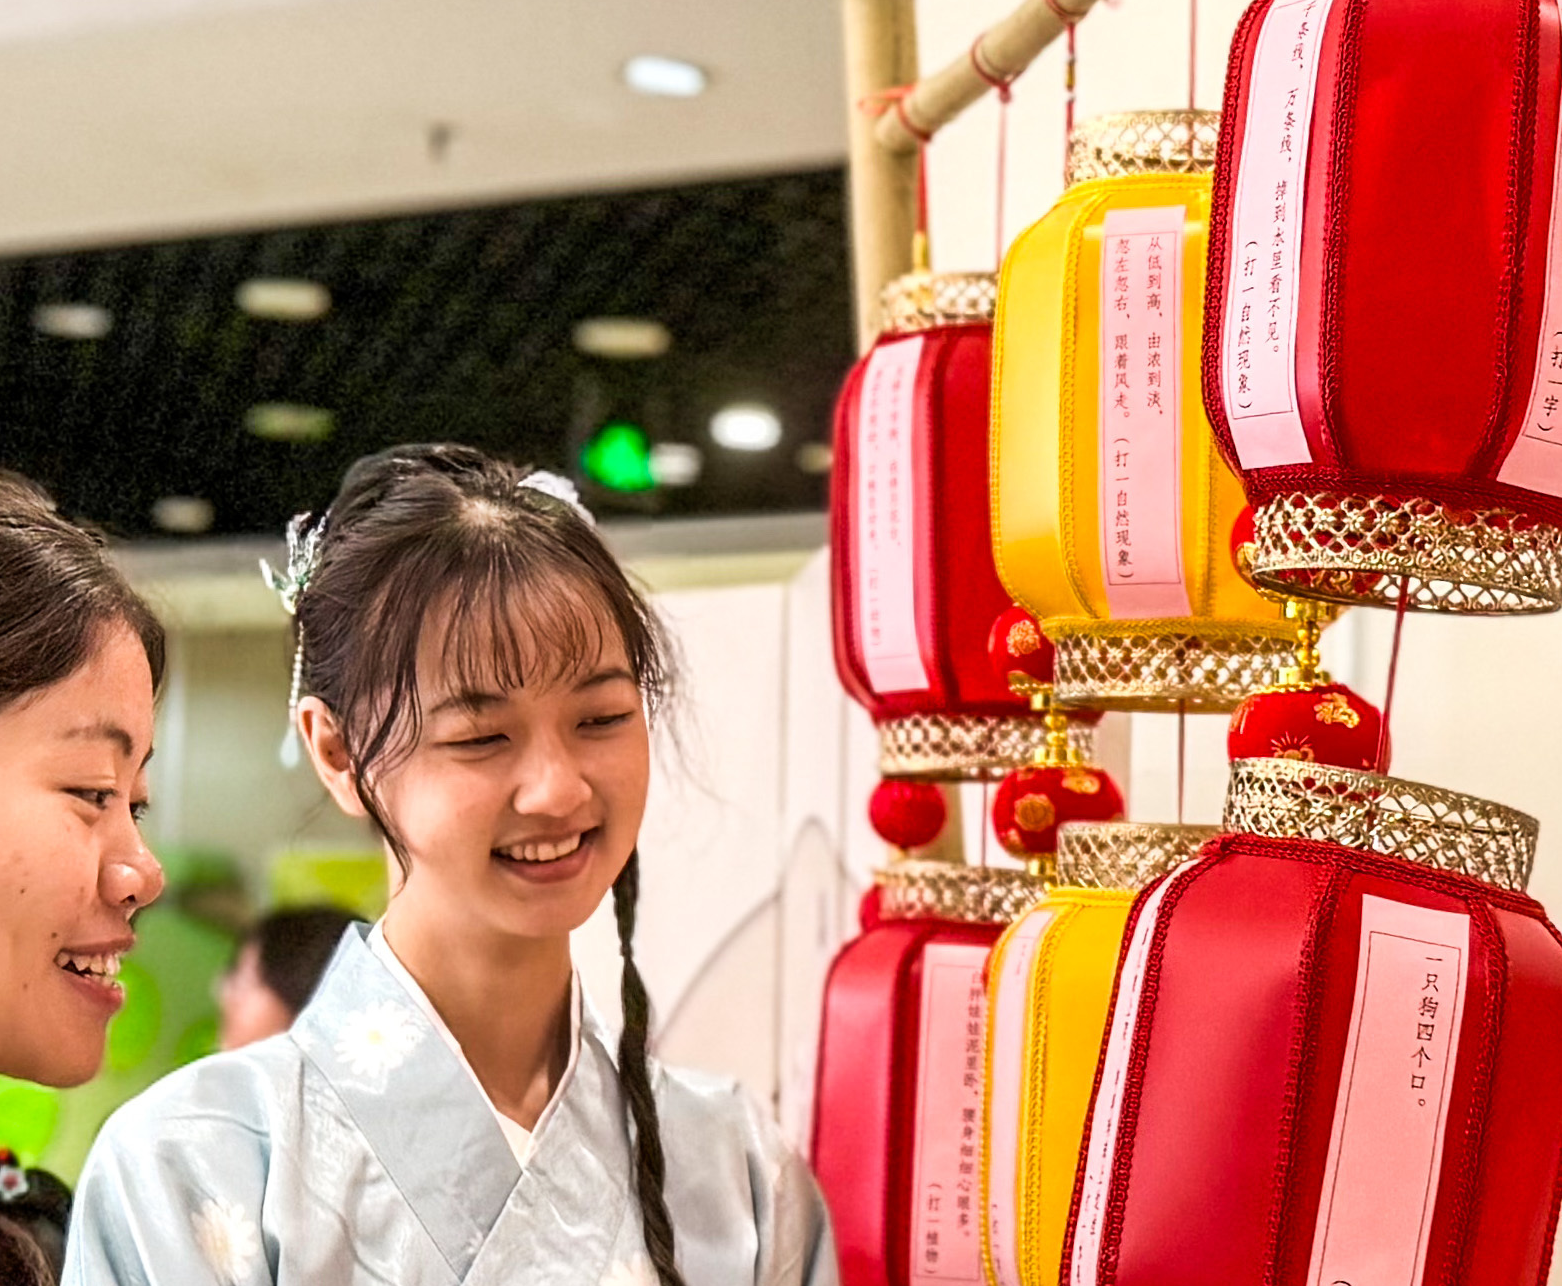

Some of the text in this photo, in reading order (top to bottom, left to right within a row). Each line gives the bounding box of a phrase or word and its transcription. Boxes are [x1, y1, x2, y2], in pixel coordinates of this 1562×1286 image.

[1410, 956, 1444, 1107] 一只狗四个口。
